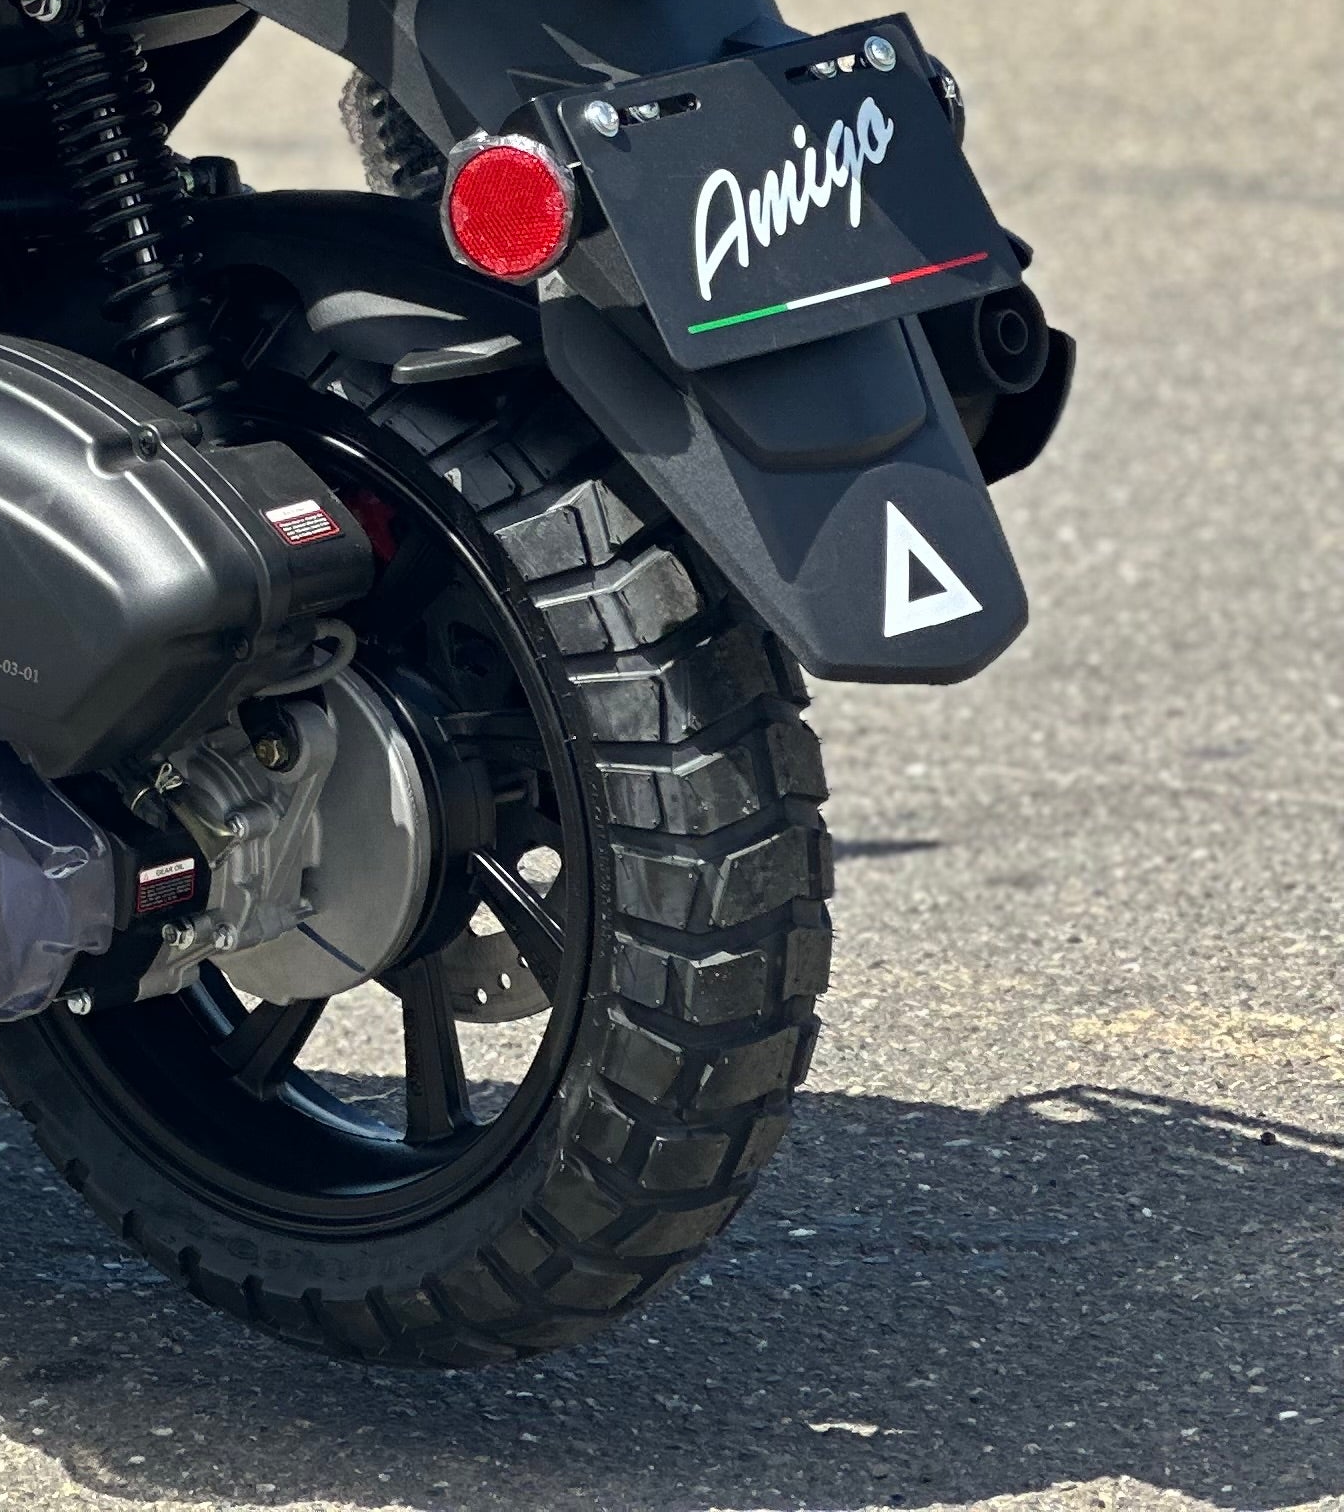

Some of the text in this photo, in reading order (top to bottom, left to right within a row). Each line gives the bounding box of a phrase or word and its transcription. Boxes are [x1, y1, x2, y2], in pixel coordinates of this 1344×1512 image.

[694, 96, 894, 301] Amigo
[155, 863, 185, 876] GEAR OIL
